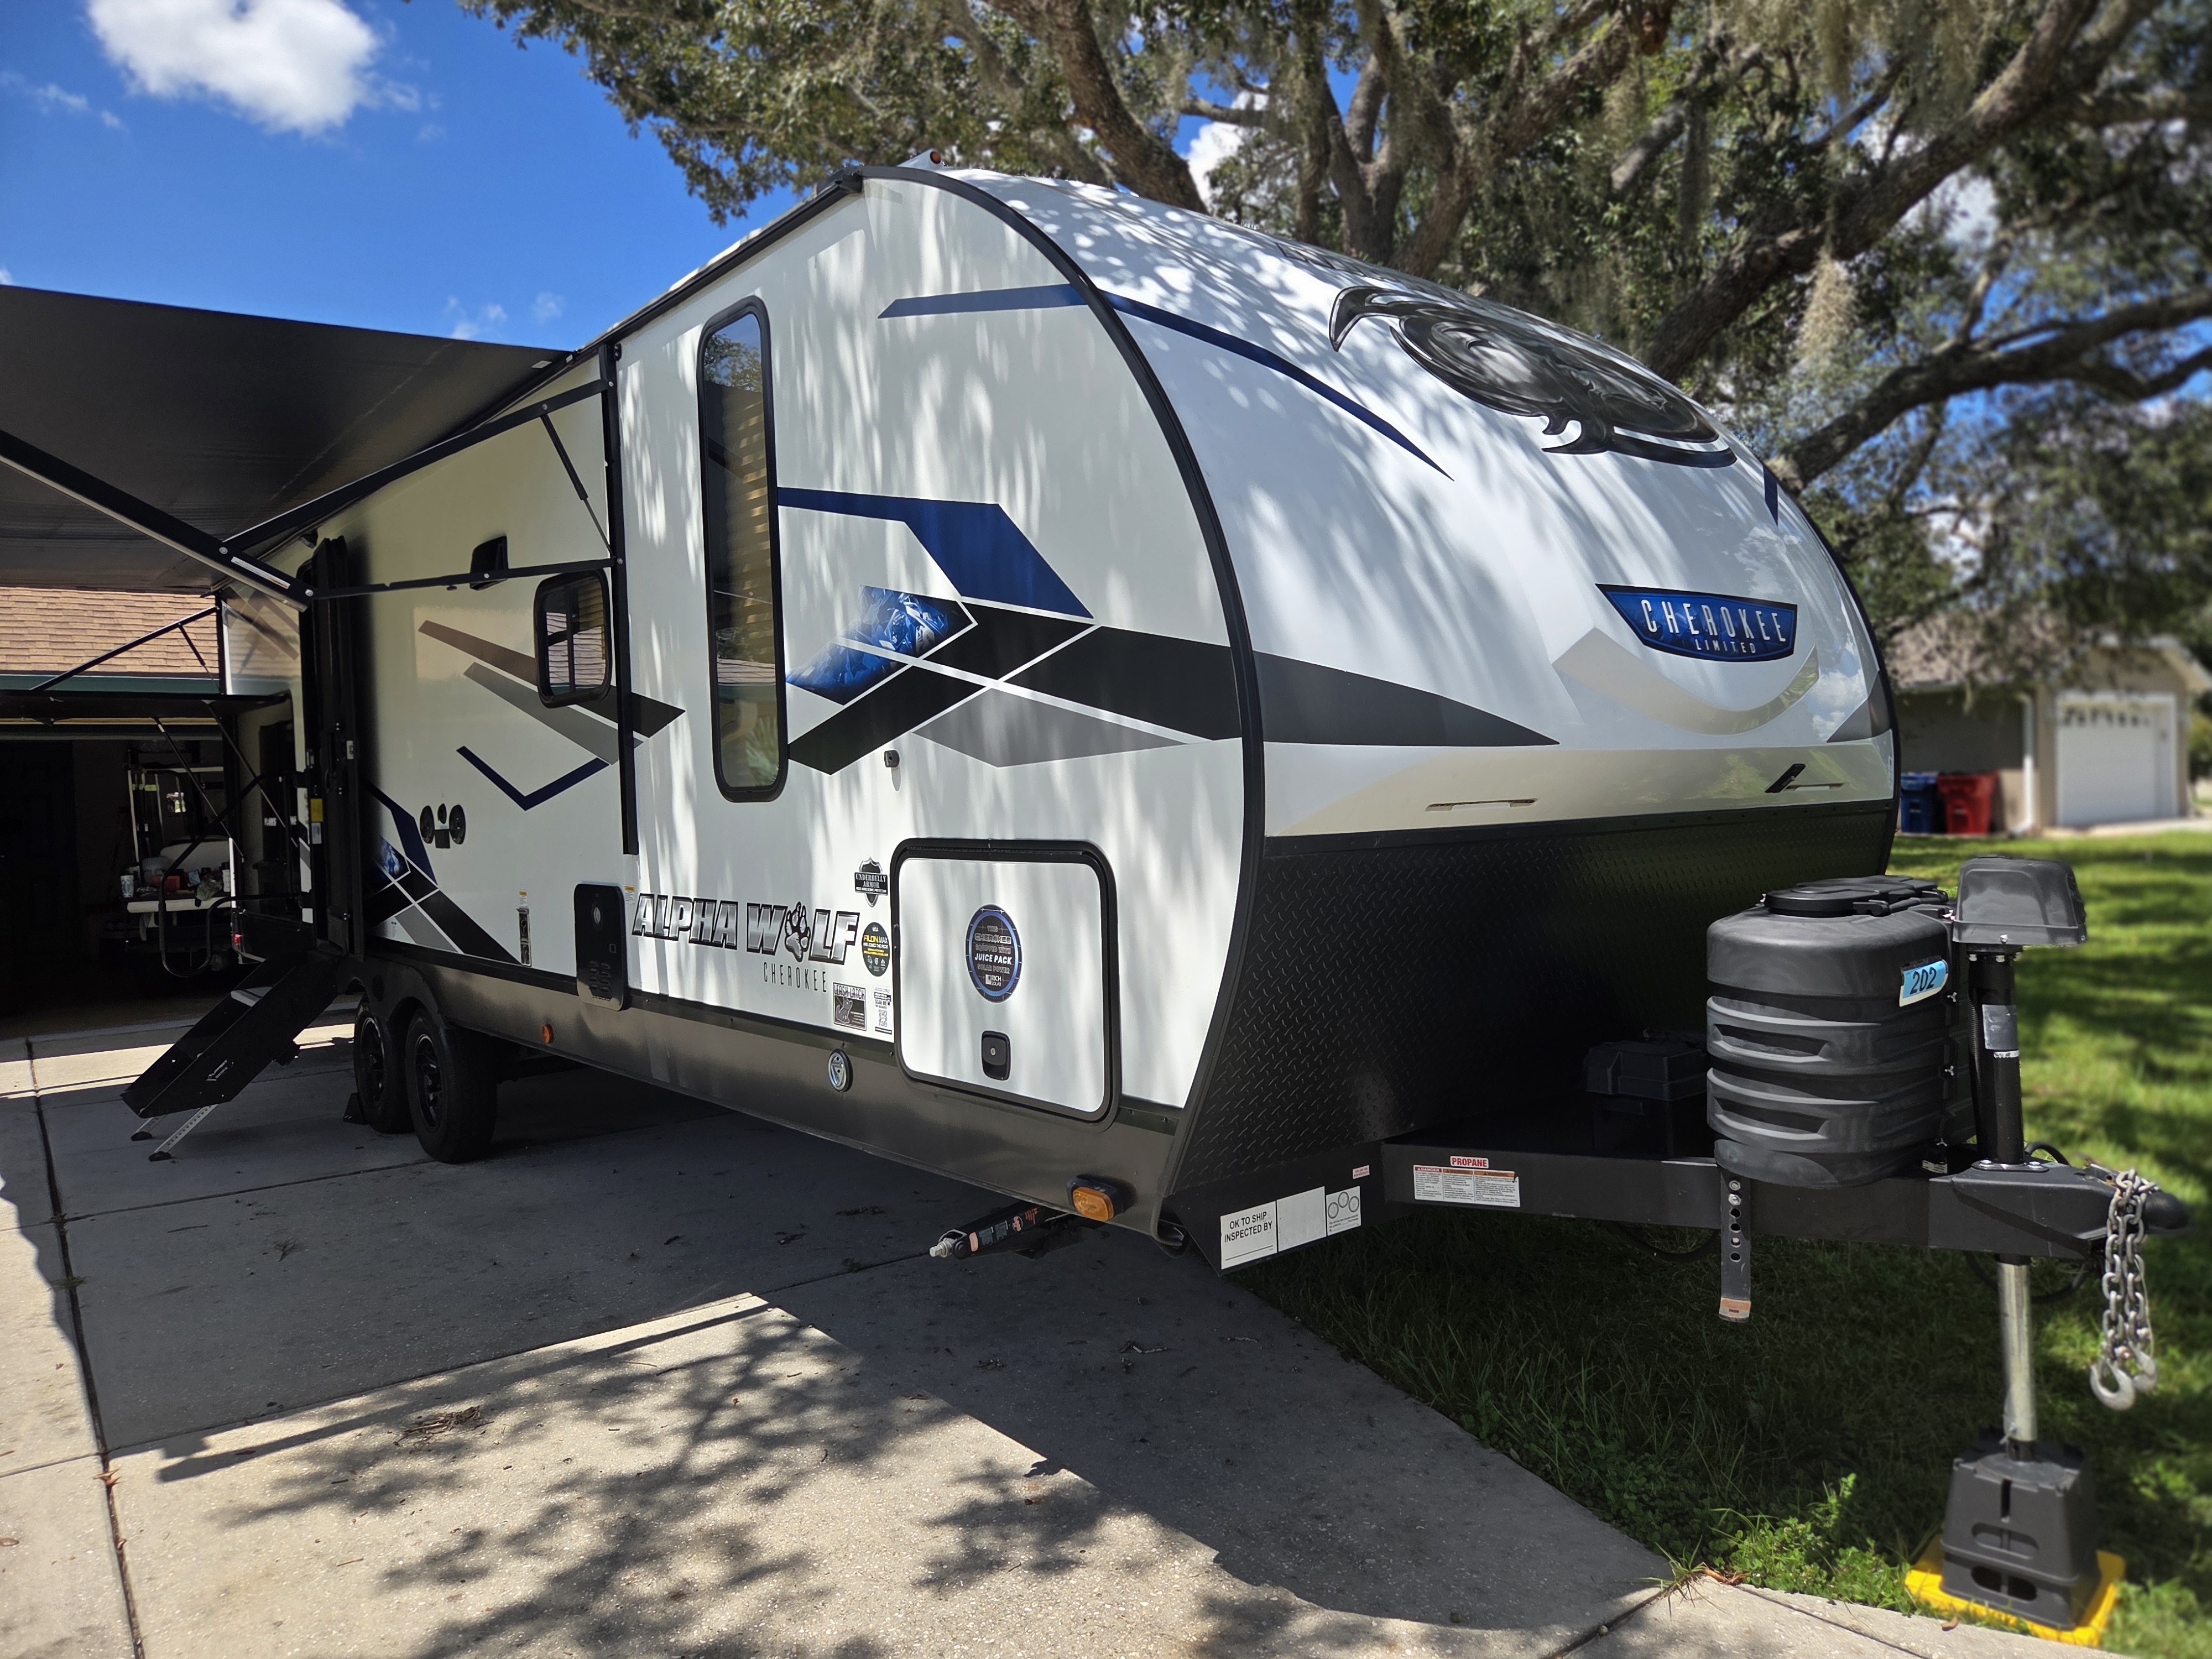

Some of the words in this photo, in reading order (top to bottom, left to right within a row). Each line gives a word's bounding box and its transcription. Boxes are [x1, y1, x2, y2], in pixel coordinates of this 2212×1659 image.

[1641, 599, 1786, 642] CHEROKEE
[1695, 639, 1756, 654] LIMITED
[855, 873, 886, 883] UNDERBELLY
[863, 880, 880, 889] ARMOR
[632, 893, 738, 950] ALPHA
[974, 933, 1011, 945] CHEROKEE
[975, 953, 993, 962] JUICE
[994, 954, 1013, 965] PACK
[977, 963, 993, 972] SOLAR
[993, 965, 1010, 974] POWER
[764, 962, 827, 993] CHEROKEE
[1910, 967, 1937, 995] 202
[1452, 1157, 1488, 1167] PROPANE
[1229, 1219, 1240, 1229] OK
[1241, 1217, 1250, 1226] TO
[1252, 1211, 1267, 1223] SHIP
[1224, 1224, 1262, 1243] INSPECTED
[1264, 1220, 1272, 1231] BY
